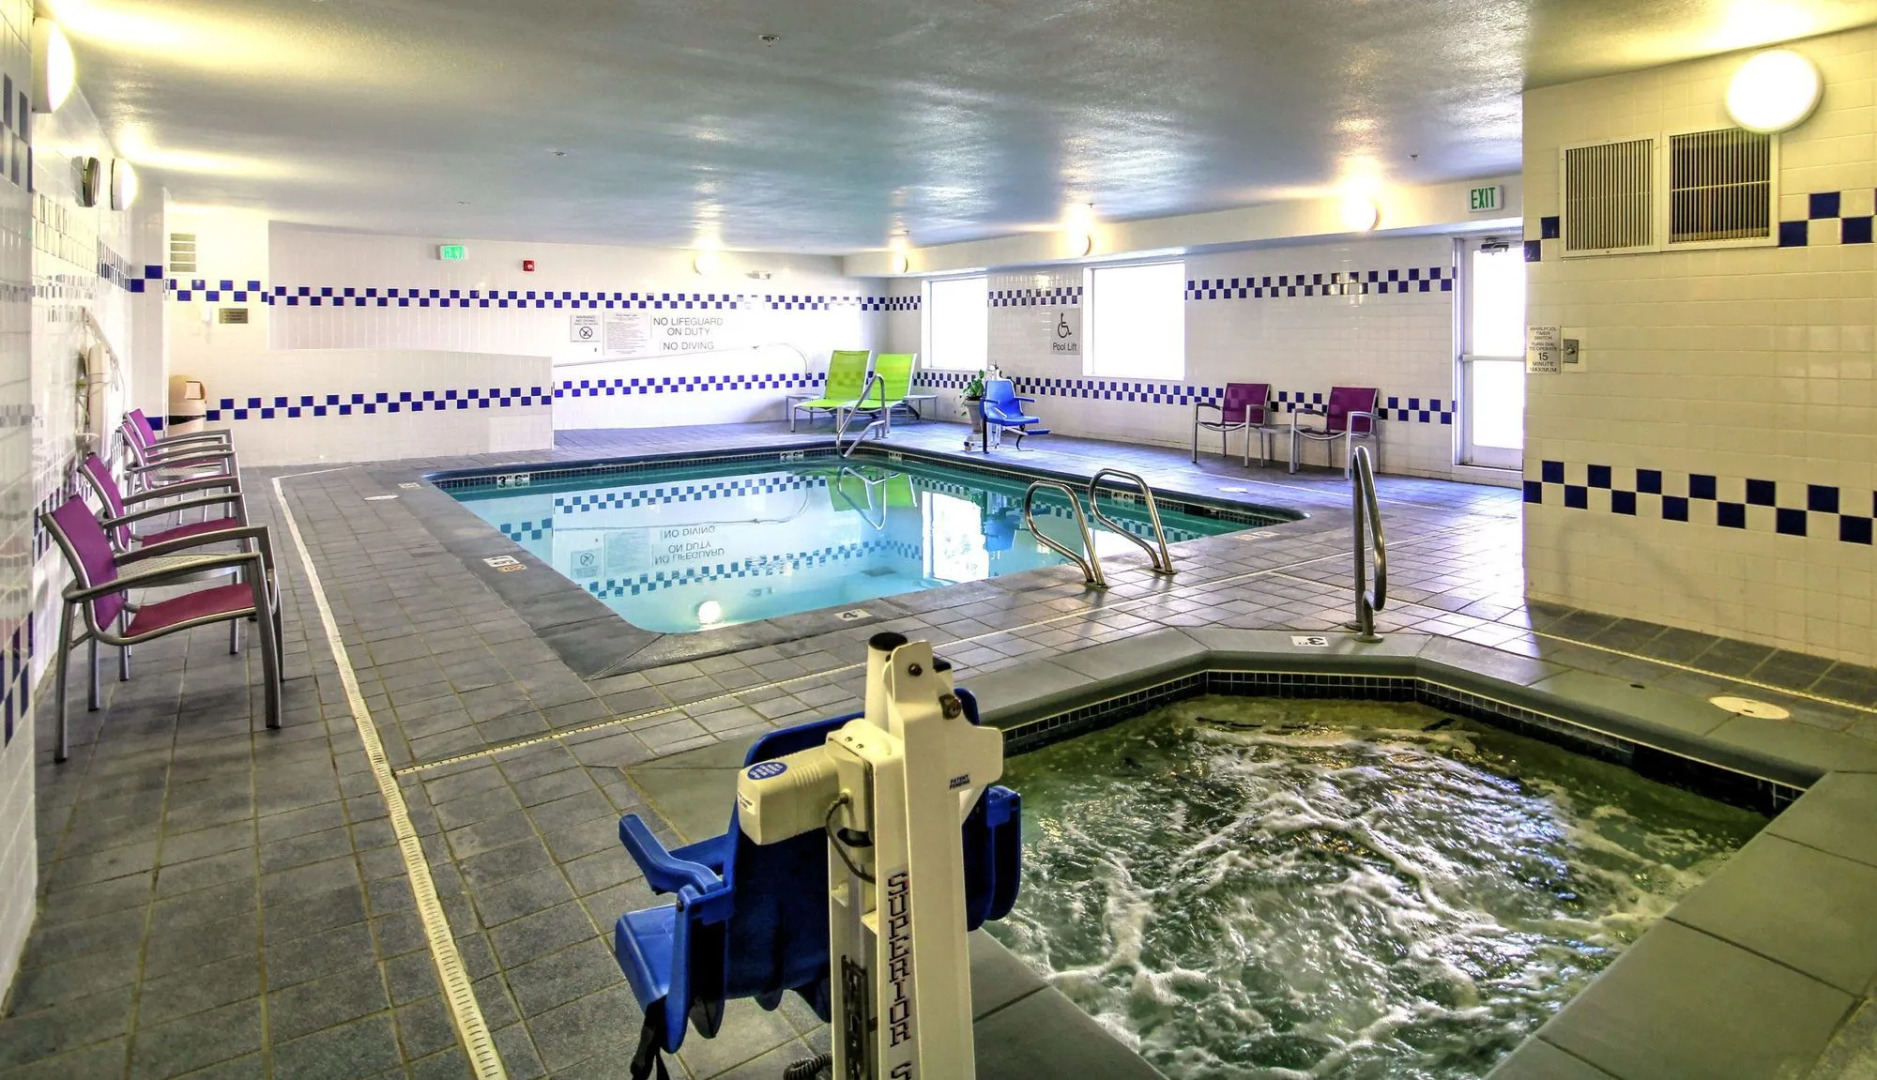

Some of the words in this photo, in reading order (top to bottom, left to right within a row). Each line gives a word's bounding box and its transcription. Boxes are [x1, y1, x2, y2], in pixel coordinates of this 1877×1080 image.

[1471, 187, 1495, 209] EXIT
[653, 317, 668, 326] NO
[671, 317, 723, 326] LIFEGUARD
[667, 328, 682, 336] ON
[685, 328, 710, 336] DUTY
[663, 342, 678, 350] NO
[681, 342, 714, 350] DIVING
[1053, 342, 1066, 351] Pool
[1068, 343, 1077, 351] Lift
[1538, 352, 1548, 361] 15
[887, 872, 911, 1048] SUPERIOR
